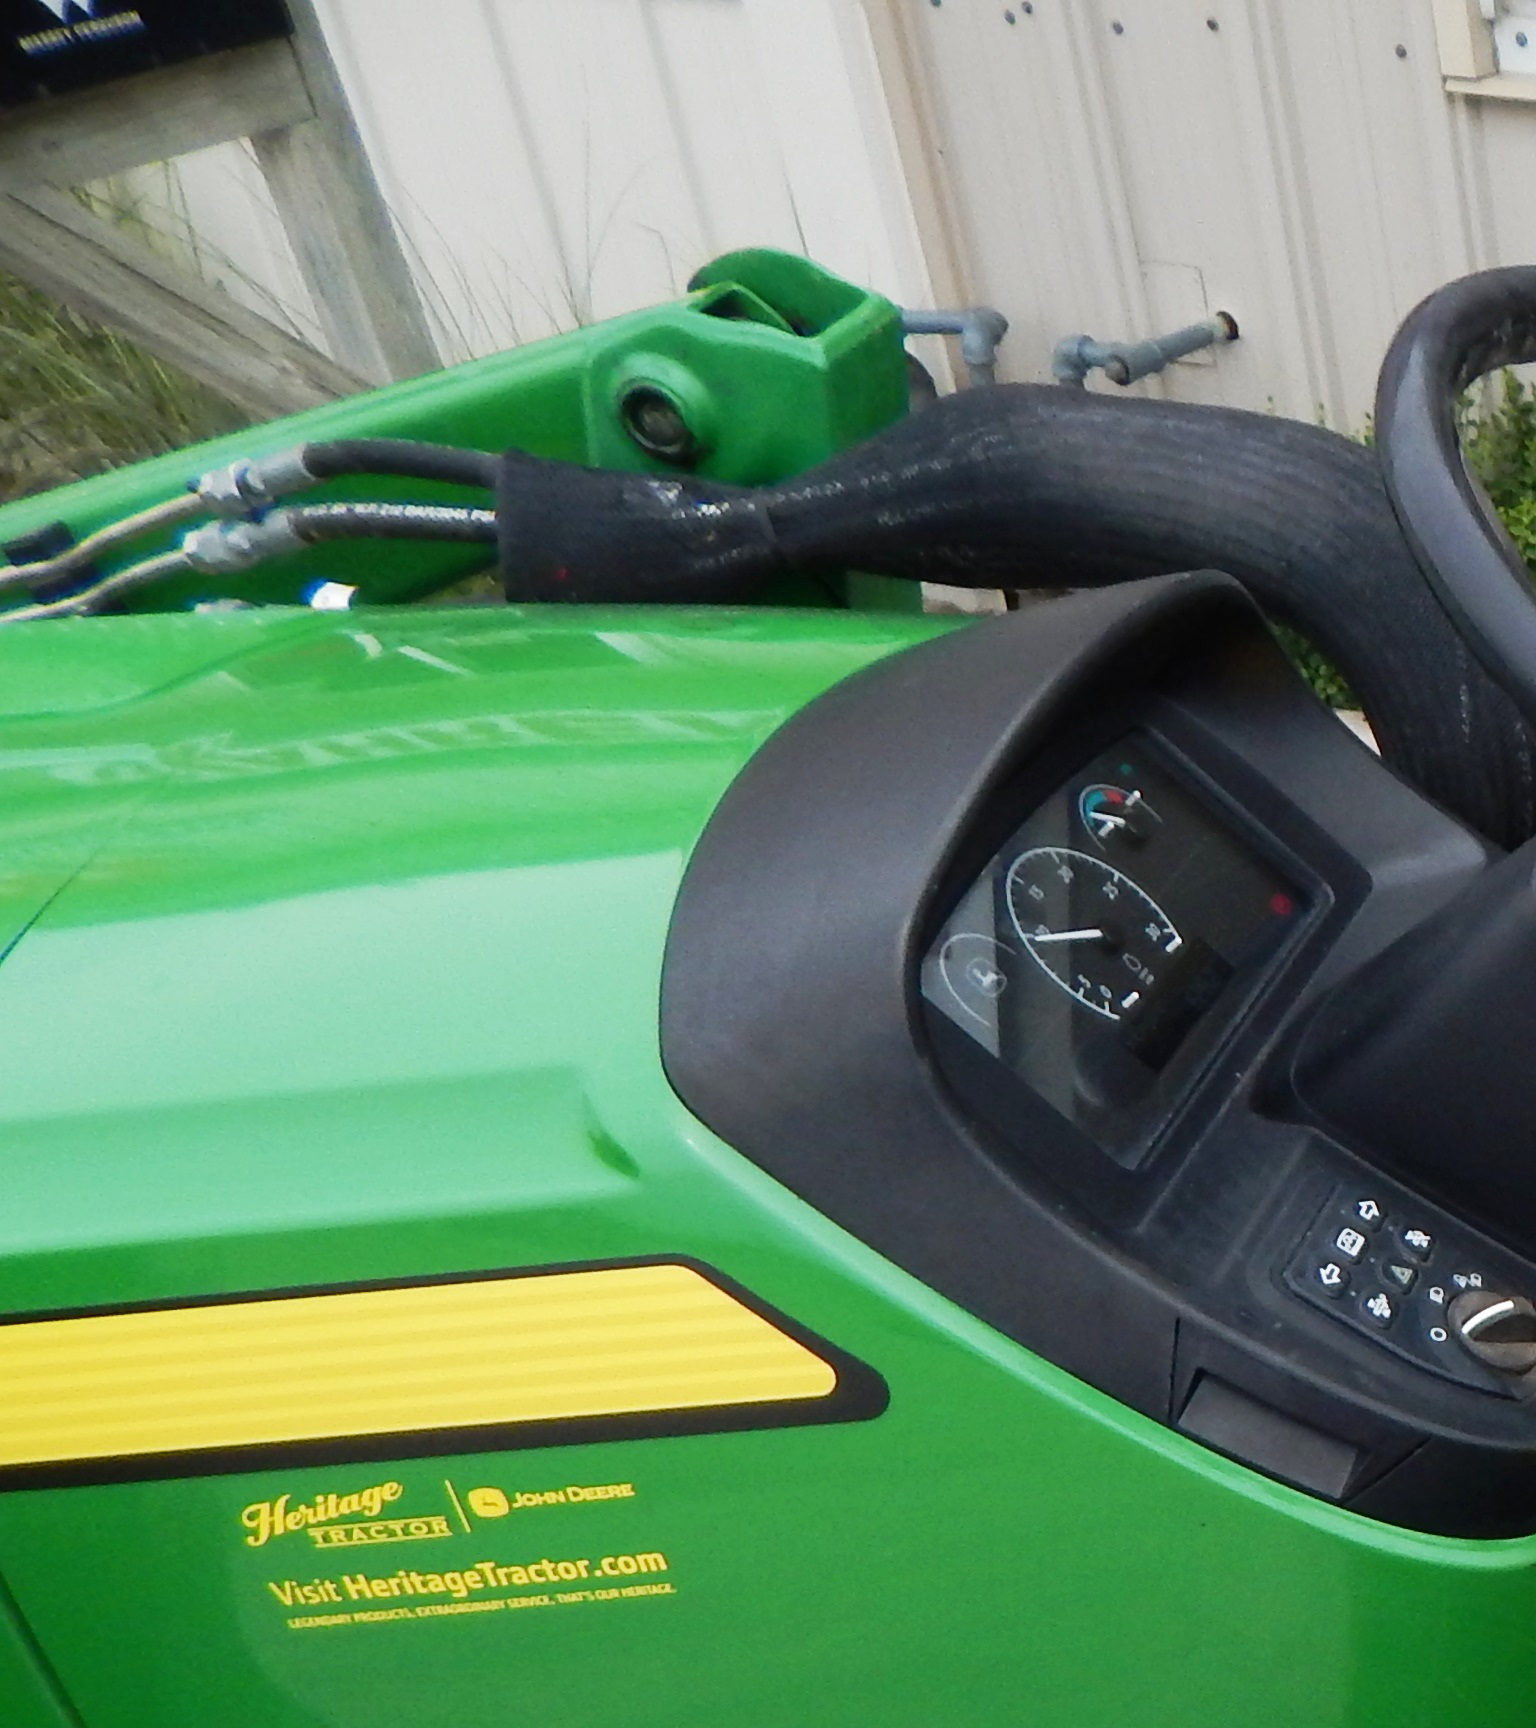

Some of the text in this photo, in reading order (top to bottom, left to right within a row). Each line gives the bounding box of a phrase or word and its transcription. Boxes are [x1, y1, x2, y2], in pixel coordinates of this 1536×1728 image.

[242, 1480, 402, 1547] Heritage
[512, 1483, 635, 1508] JOHN DEERE
[311, 1519, 451, 1547] TRACTOR
[268, 1550, 667, 1608] Visit HeritageTractor.com
